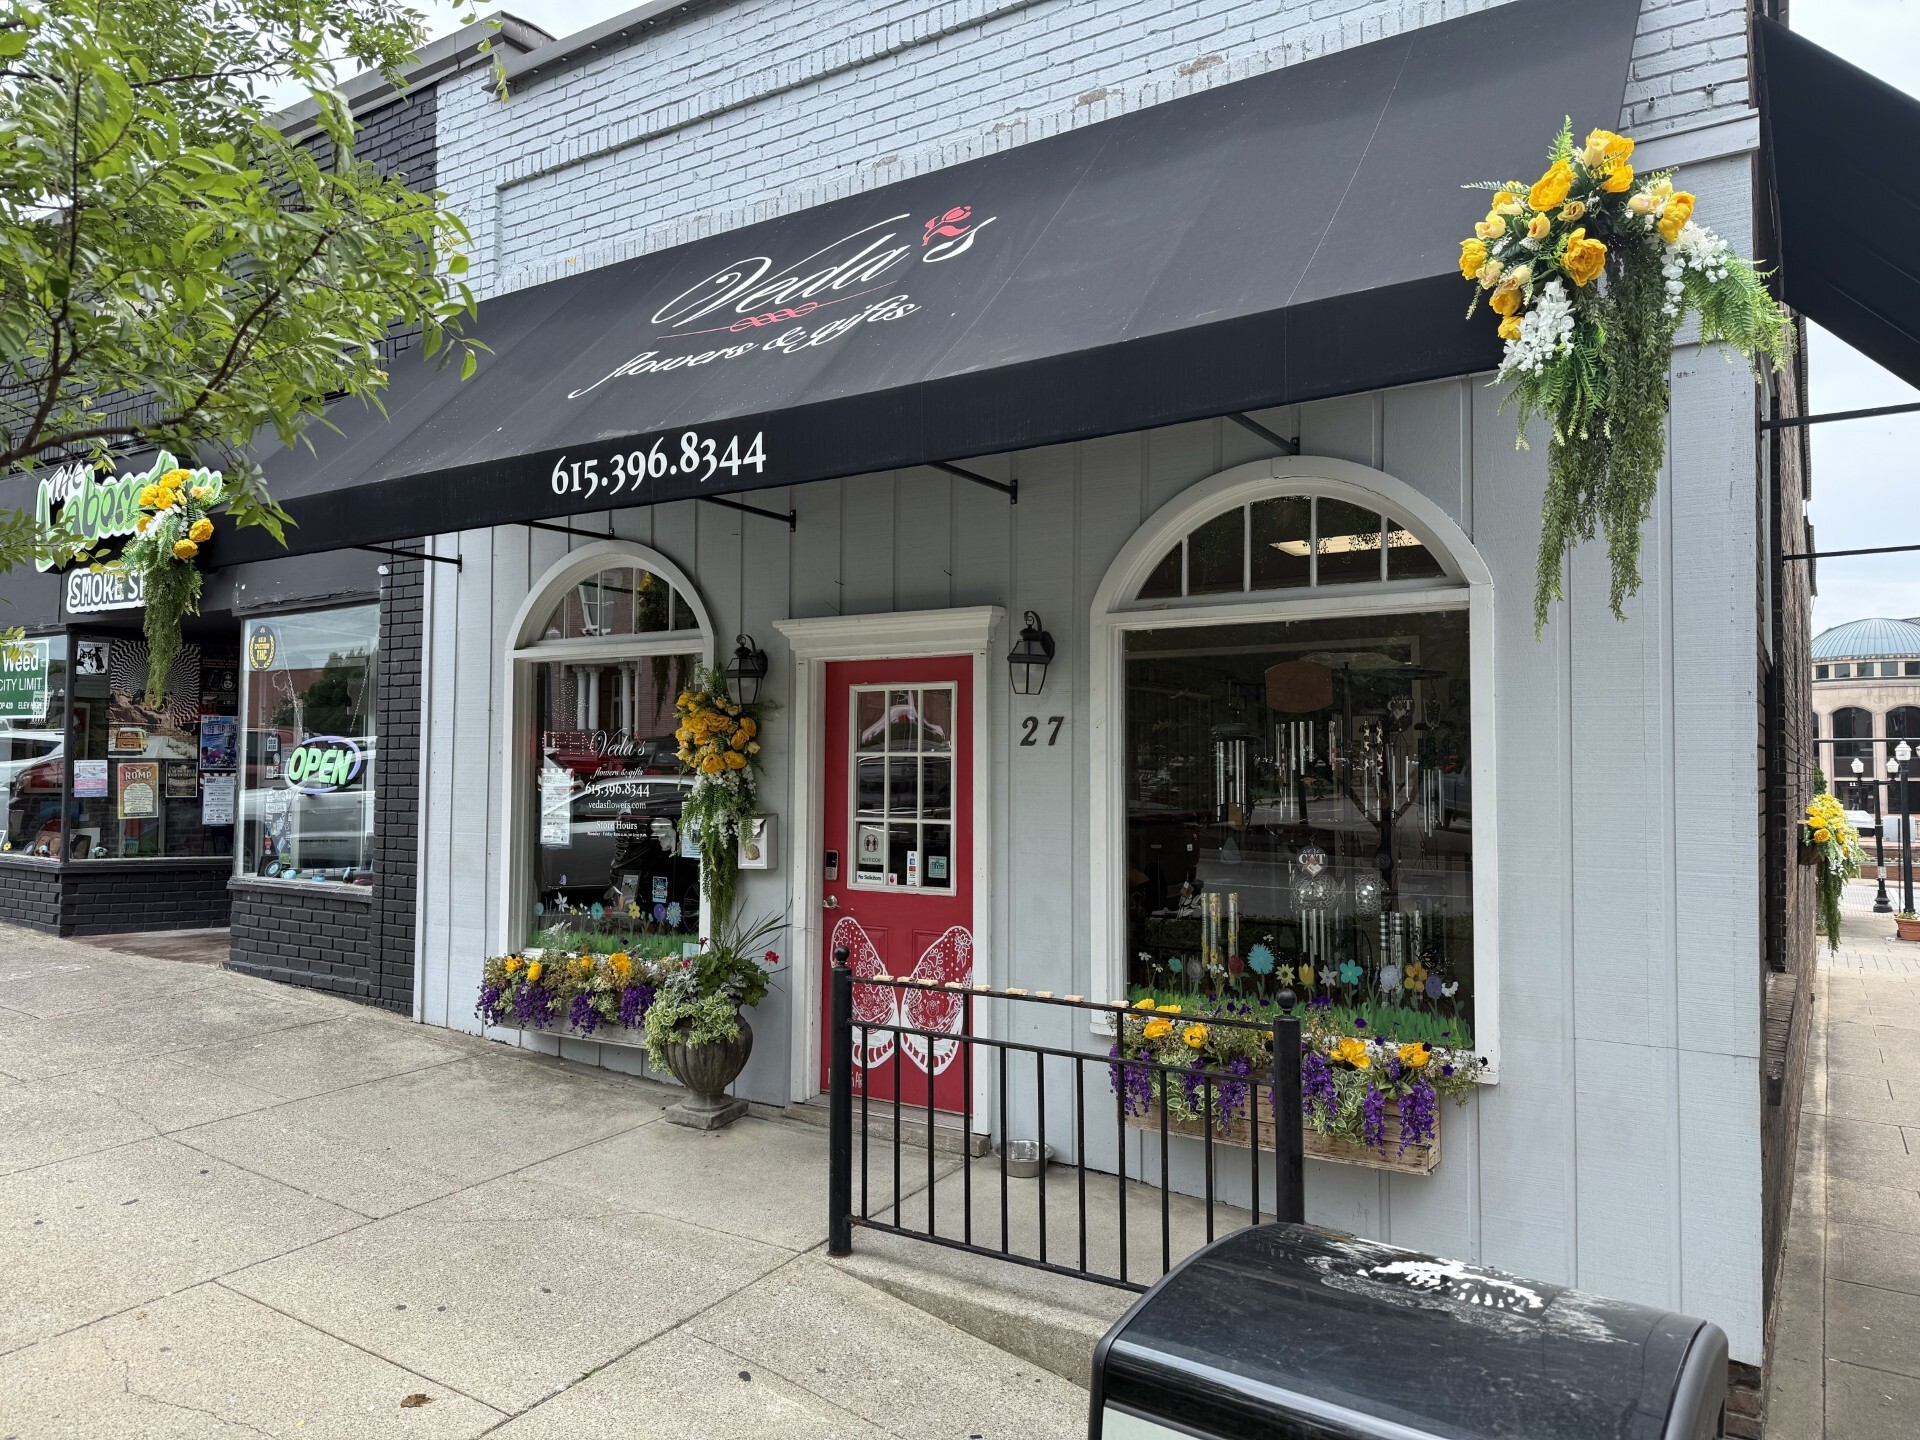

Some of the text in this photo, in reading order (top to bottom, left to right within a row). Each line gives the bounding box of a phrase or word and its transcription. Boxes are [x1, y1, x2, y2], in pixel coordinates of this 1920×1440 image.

[567, 294, 921, 399] flowers & gifts
[551, 431, 767, 500] 615.396.8344
[50, 460, 85, 505] THE
[70, 573, 125, 605] SMOKE
[2, 648, 40, 672] Weed
[19, 677, 43, 691] LIMIT
[1020, 716, 1064, 746] 27
[125, 771, 152, 781] ROMP
[288, 747, 353, 785] OPEN
[590, 766, 619, 779] flowers
[626, 766, 644, 779] gifts
[585, 781, 650, 798] 615.396.8344
[588, 799, 647, 809] vedasflowers.com
[596, 820, 638, 830] Store Hours
